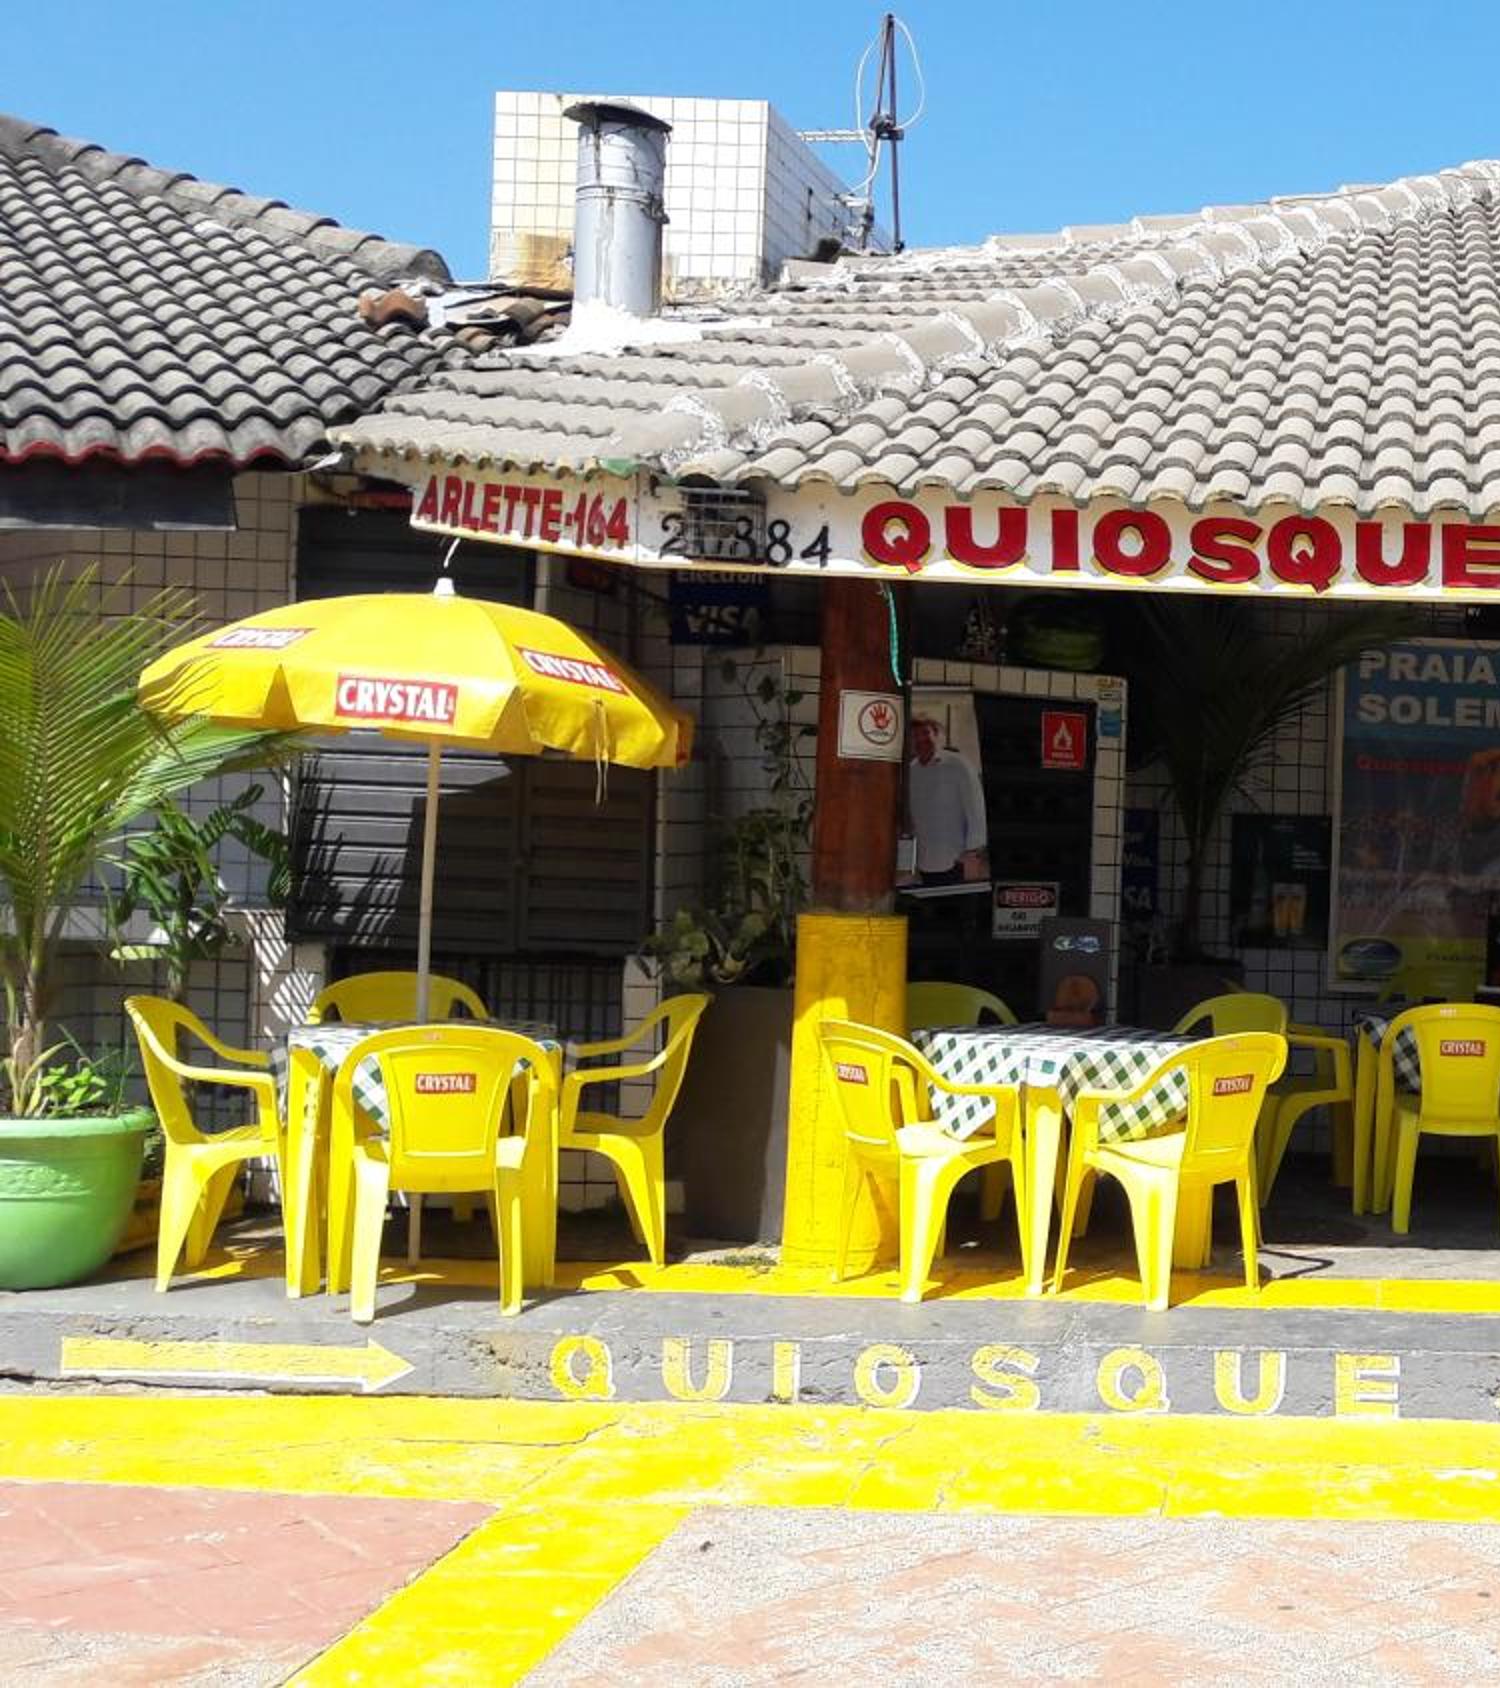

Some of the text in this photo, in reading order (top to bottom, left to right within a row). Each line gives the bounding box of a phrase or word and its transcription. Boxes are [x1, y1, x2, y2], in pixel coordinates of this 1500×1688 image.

[522, 650, 622, 692] CRYSTAL
[1359, 650, 1497, 684] PRAIA
[338, 679, 450, 720] CRYSTAL
[1440, 1041, 1483, 1055] CRYSTAL
[417, 1074, 473, 1092] CRYSTAL
[549, 1334, 1401, 1420] QUIOSQUE
